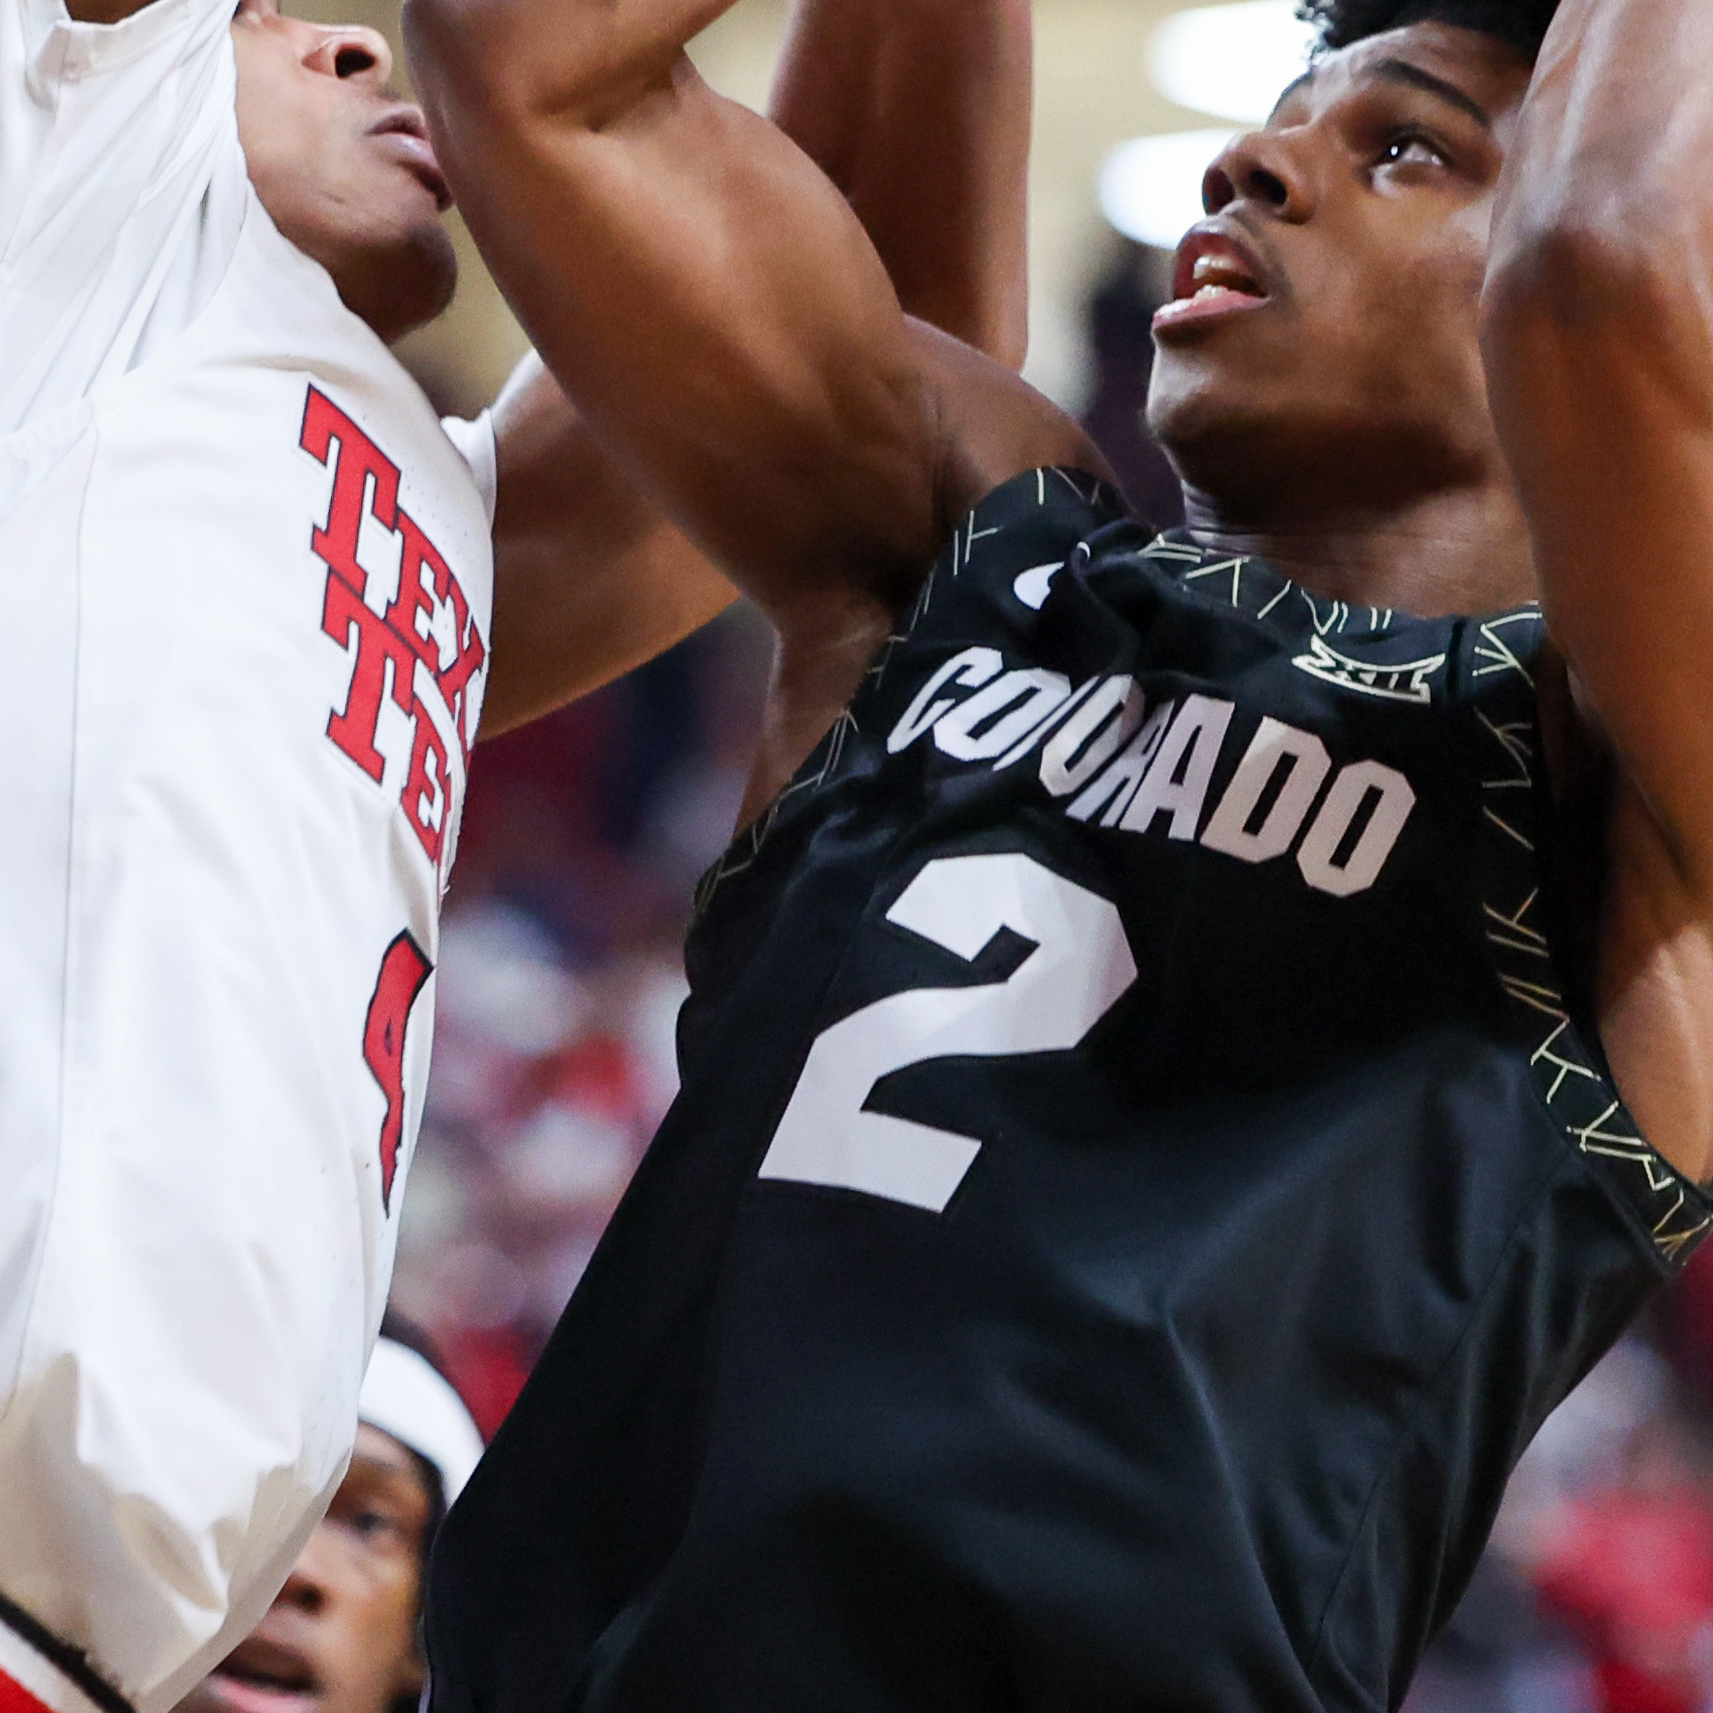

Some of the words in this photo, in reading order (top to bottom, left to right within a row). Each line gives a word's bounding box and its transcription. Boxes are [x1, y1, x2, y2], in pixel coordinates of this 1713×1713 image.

[298, 382, 485, 768] TEX
[320, 567, 452, 868] TE
[757, 852, 1139, 1214] 2
